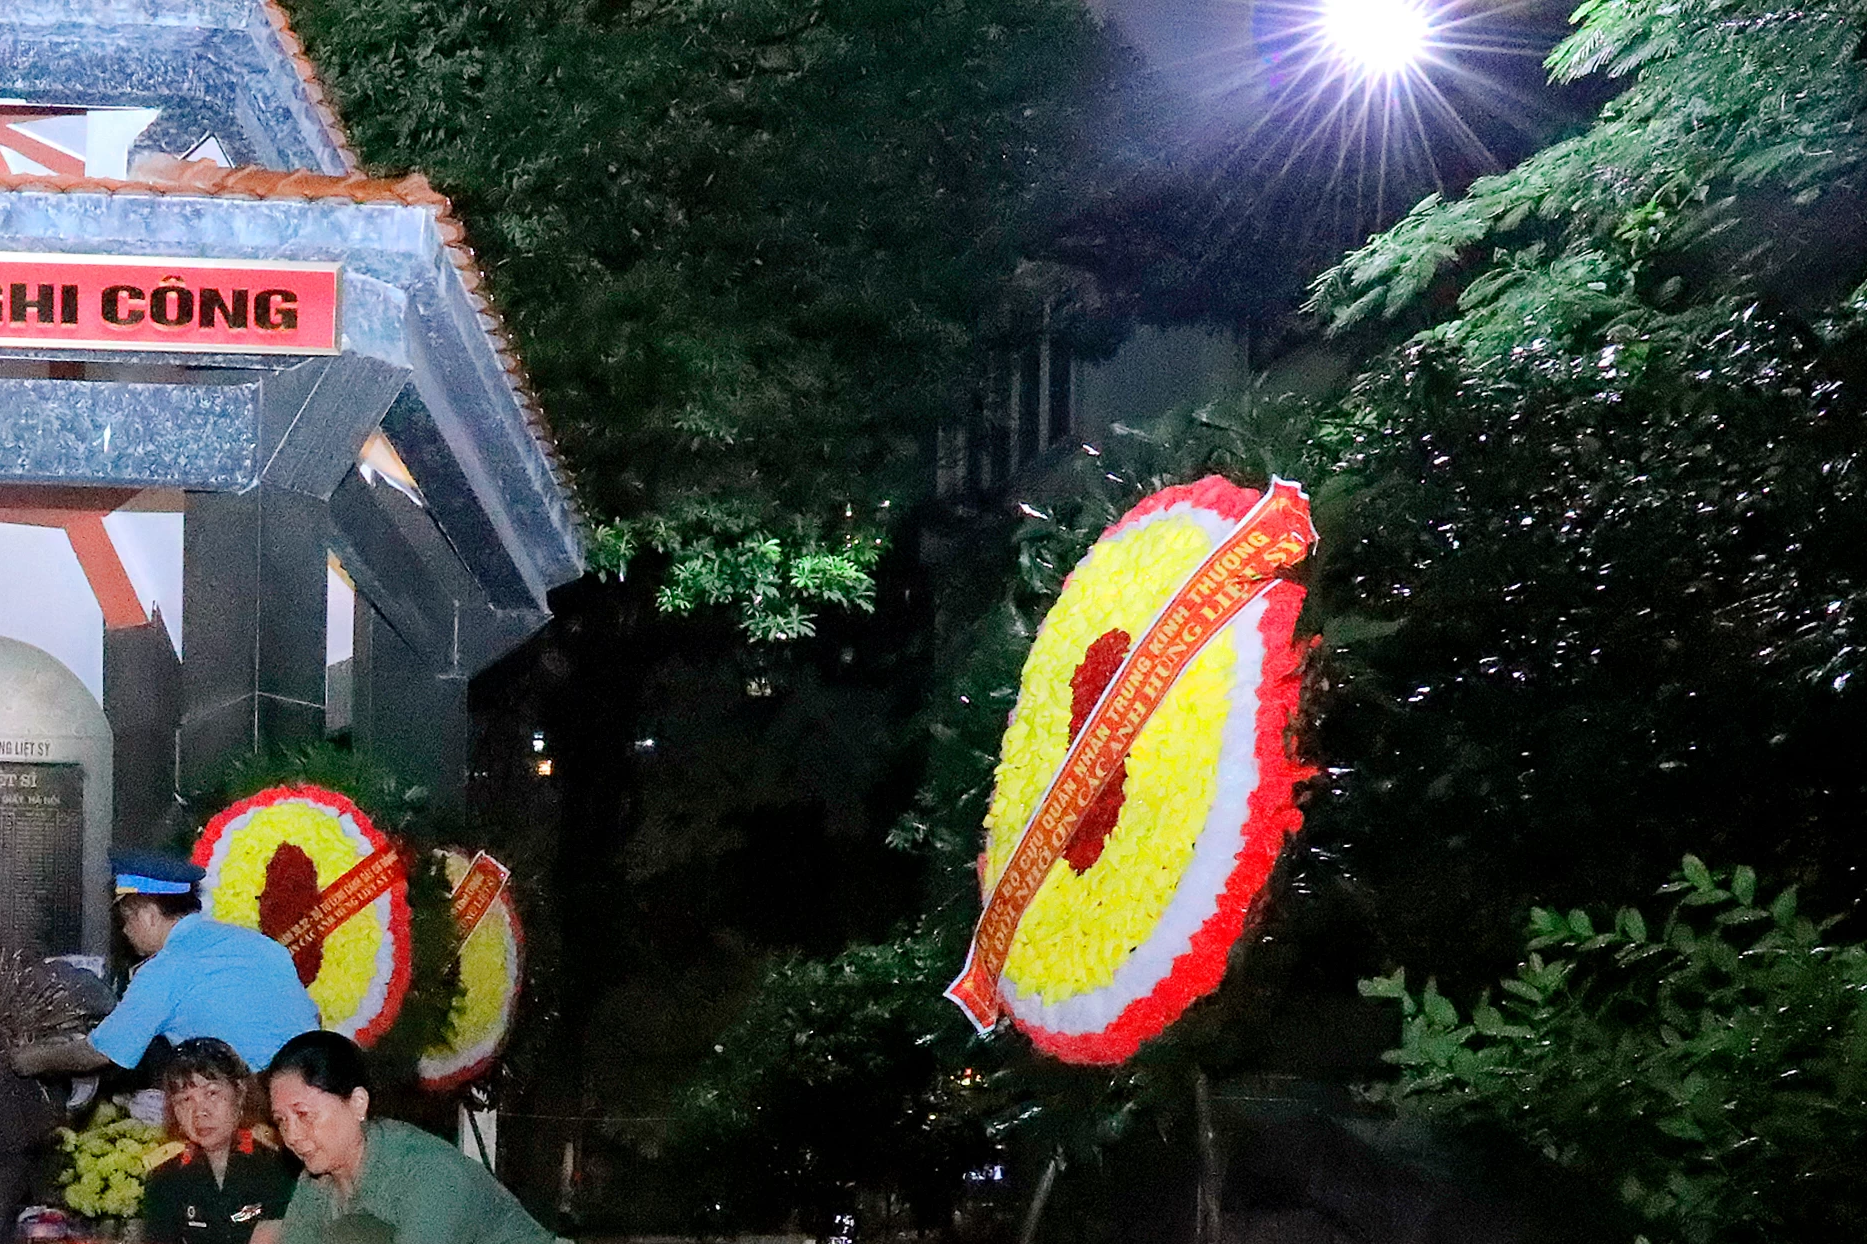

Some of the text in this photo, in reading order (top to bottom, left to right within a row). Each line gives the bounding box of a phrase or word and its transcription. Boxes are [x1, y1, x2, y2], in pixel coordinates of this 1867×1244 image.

[101, 275, 299, 331] CÔNG
[1042, 777, 1077, 830] QUÂN
[1074, 723, 1111, 777] NHÂN
[1107, 656, 1152, 722] TRUNG
[1149, 605, 1190, 656] KÍNH
[1187, 531, 1271, 604] THƯỢNG
[1052, 808, 1078, 848] ƠN
[1078, 757, 1108, 807] CÁC
[1111, 701, 1148, 759] ANH
[1144, 622, 1203, 700] HÙNG
[1263, 533, 1303, 567] SỸ
